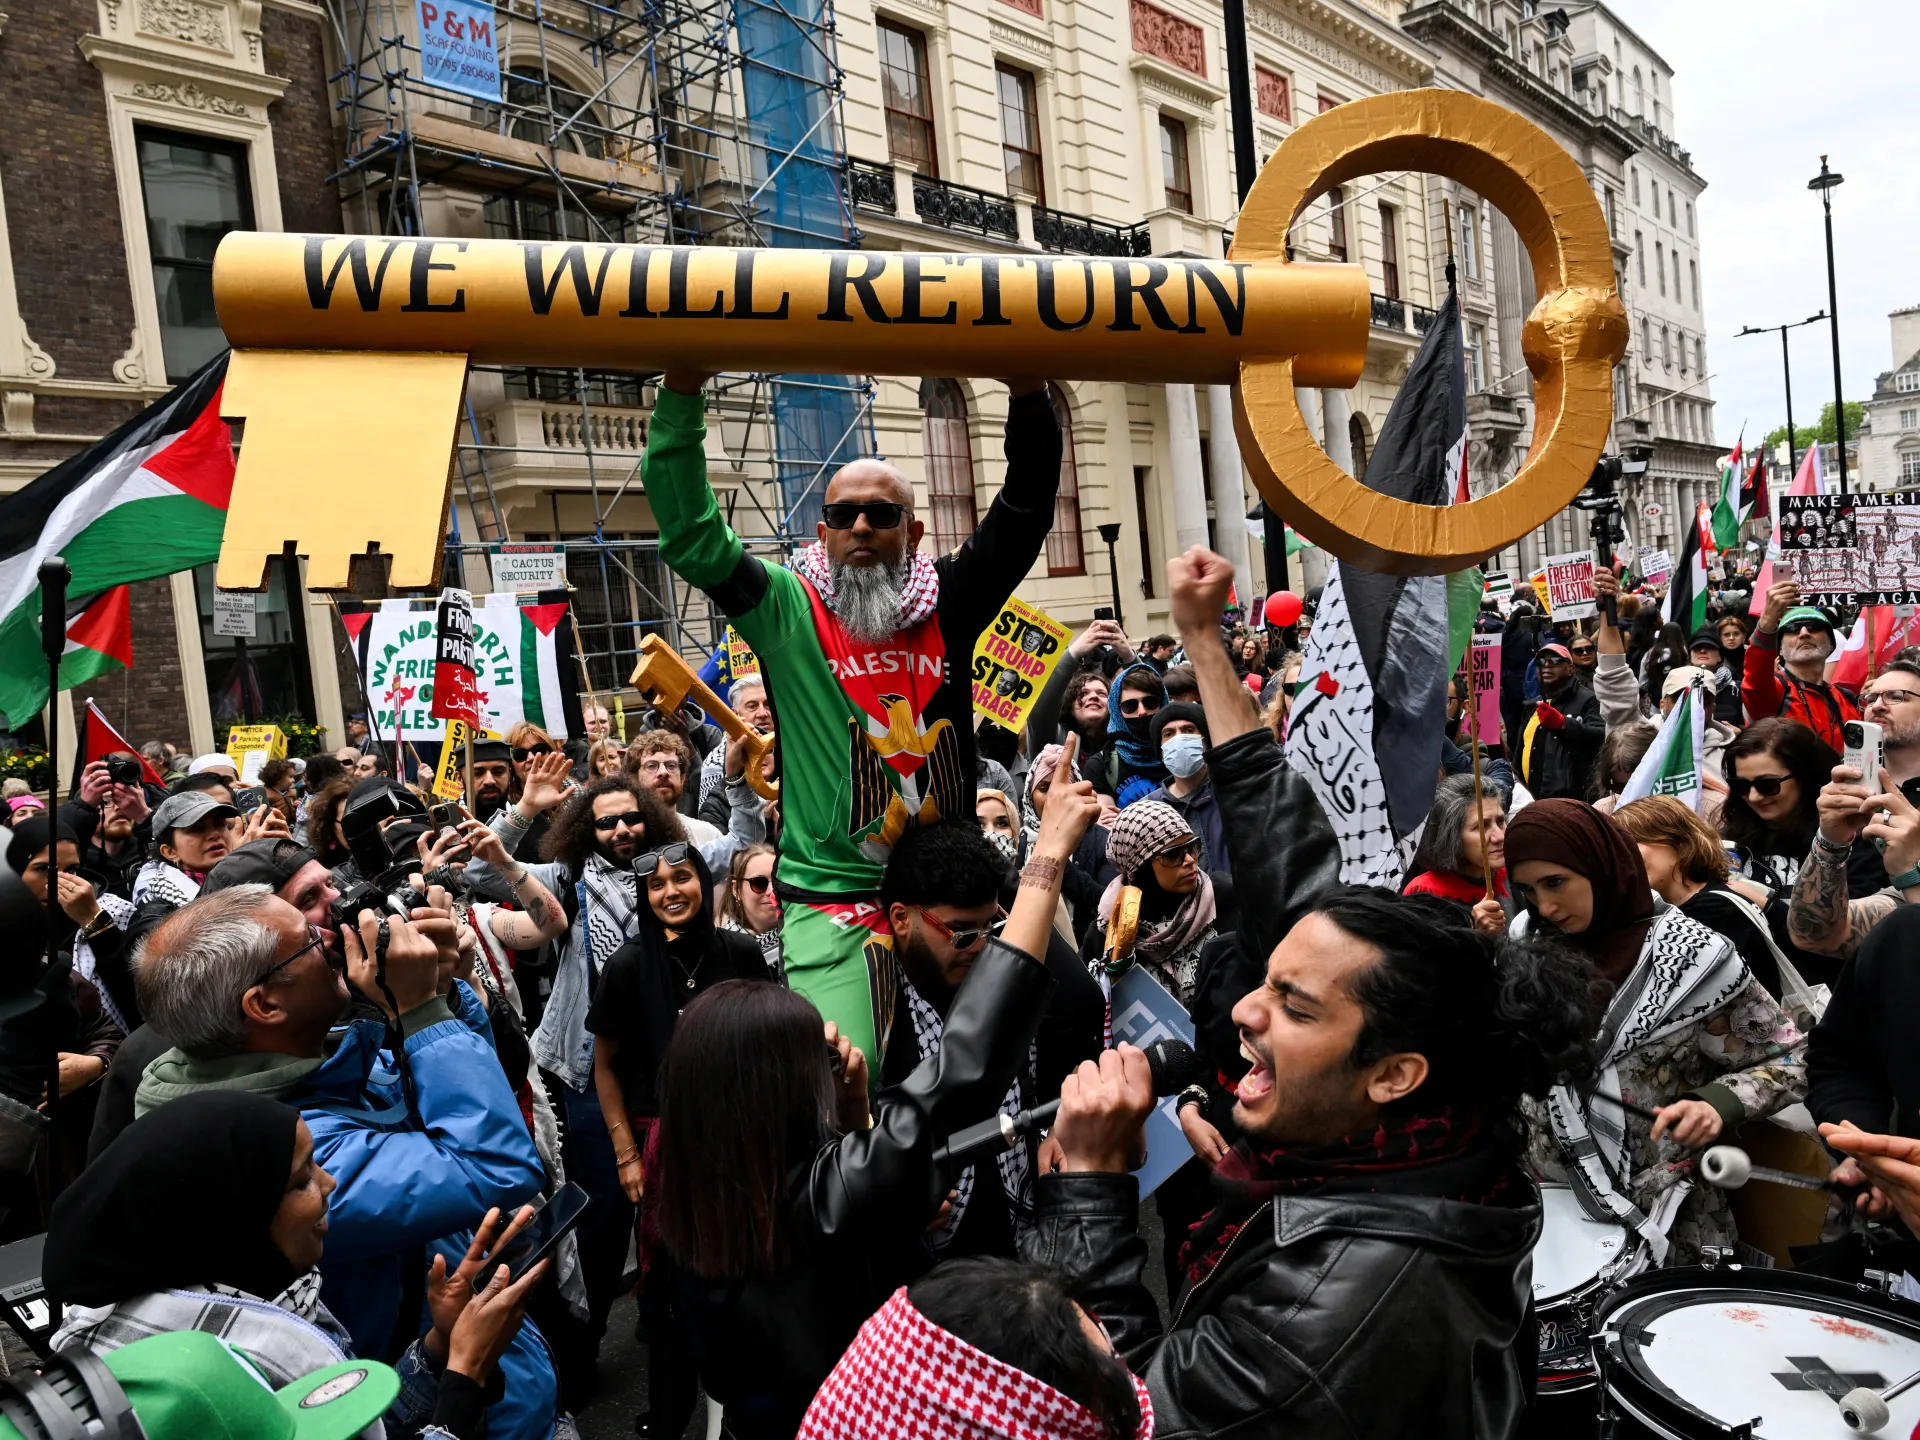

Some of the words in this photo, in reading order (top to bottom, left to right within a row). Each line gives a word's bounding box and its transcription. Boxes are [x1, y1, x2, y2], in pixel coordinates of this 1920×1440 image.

[421, 1, 438, 29] P
[444, 10, 464, 40] &
[468, 15, 491, 48] M
[425, 33, 494, 63] SCAFFOLDING
[427, 54, 457, 72] 01795
[460, 63, 496, 83] 520468
[300, 235, 469, 312] WE
[517, 242, 790, 320] WILL
[817, 251, 1252, 336] RETURN
[1789, 495, 1841, 508] MAKE
[1852, 492, 1916, 507] AMERI
[500, 545, 544, 554] PROTECTED
[544, 545, 555, 553] BY
[511, 558, 554, 569] CACTUS
[1547, 561, 1593, 585] FREEDOM
[501, 571, 553, 581] SECURITY
[1550, 580, 1596, 605] PALESTIN
[1800, 593, 1857, 605] FAKE
[1013, 604, 1031, 618] STAND
[1030, 612, 1039, 621] UP
[1039, 618, 1046, 627] TO
[1045, 622, 1065, 639] RACISM
[995, 611, 1058, 659] STOP
[731, 642, 750, 653] TRUM
[984, 633, 1046, 678] TRUMP
[733, 664, 757, 676] FARAGE
[972, 655, 1034, 703] STOP
[972, 683, 1022, 724] ARAGE
[480, 721, 493, 729] ACISM
[1116, 775, 1140, 795] BLIND
